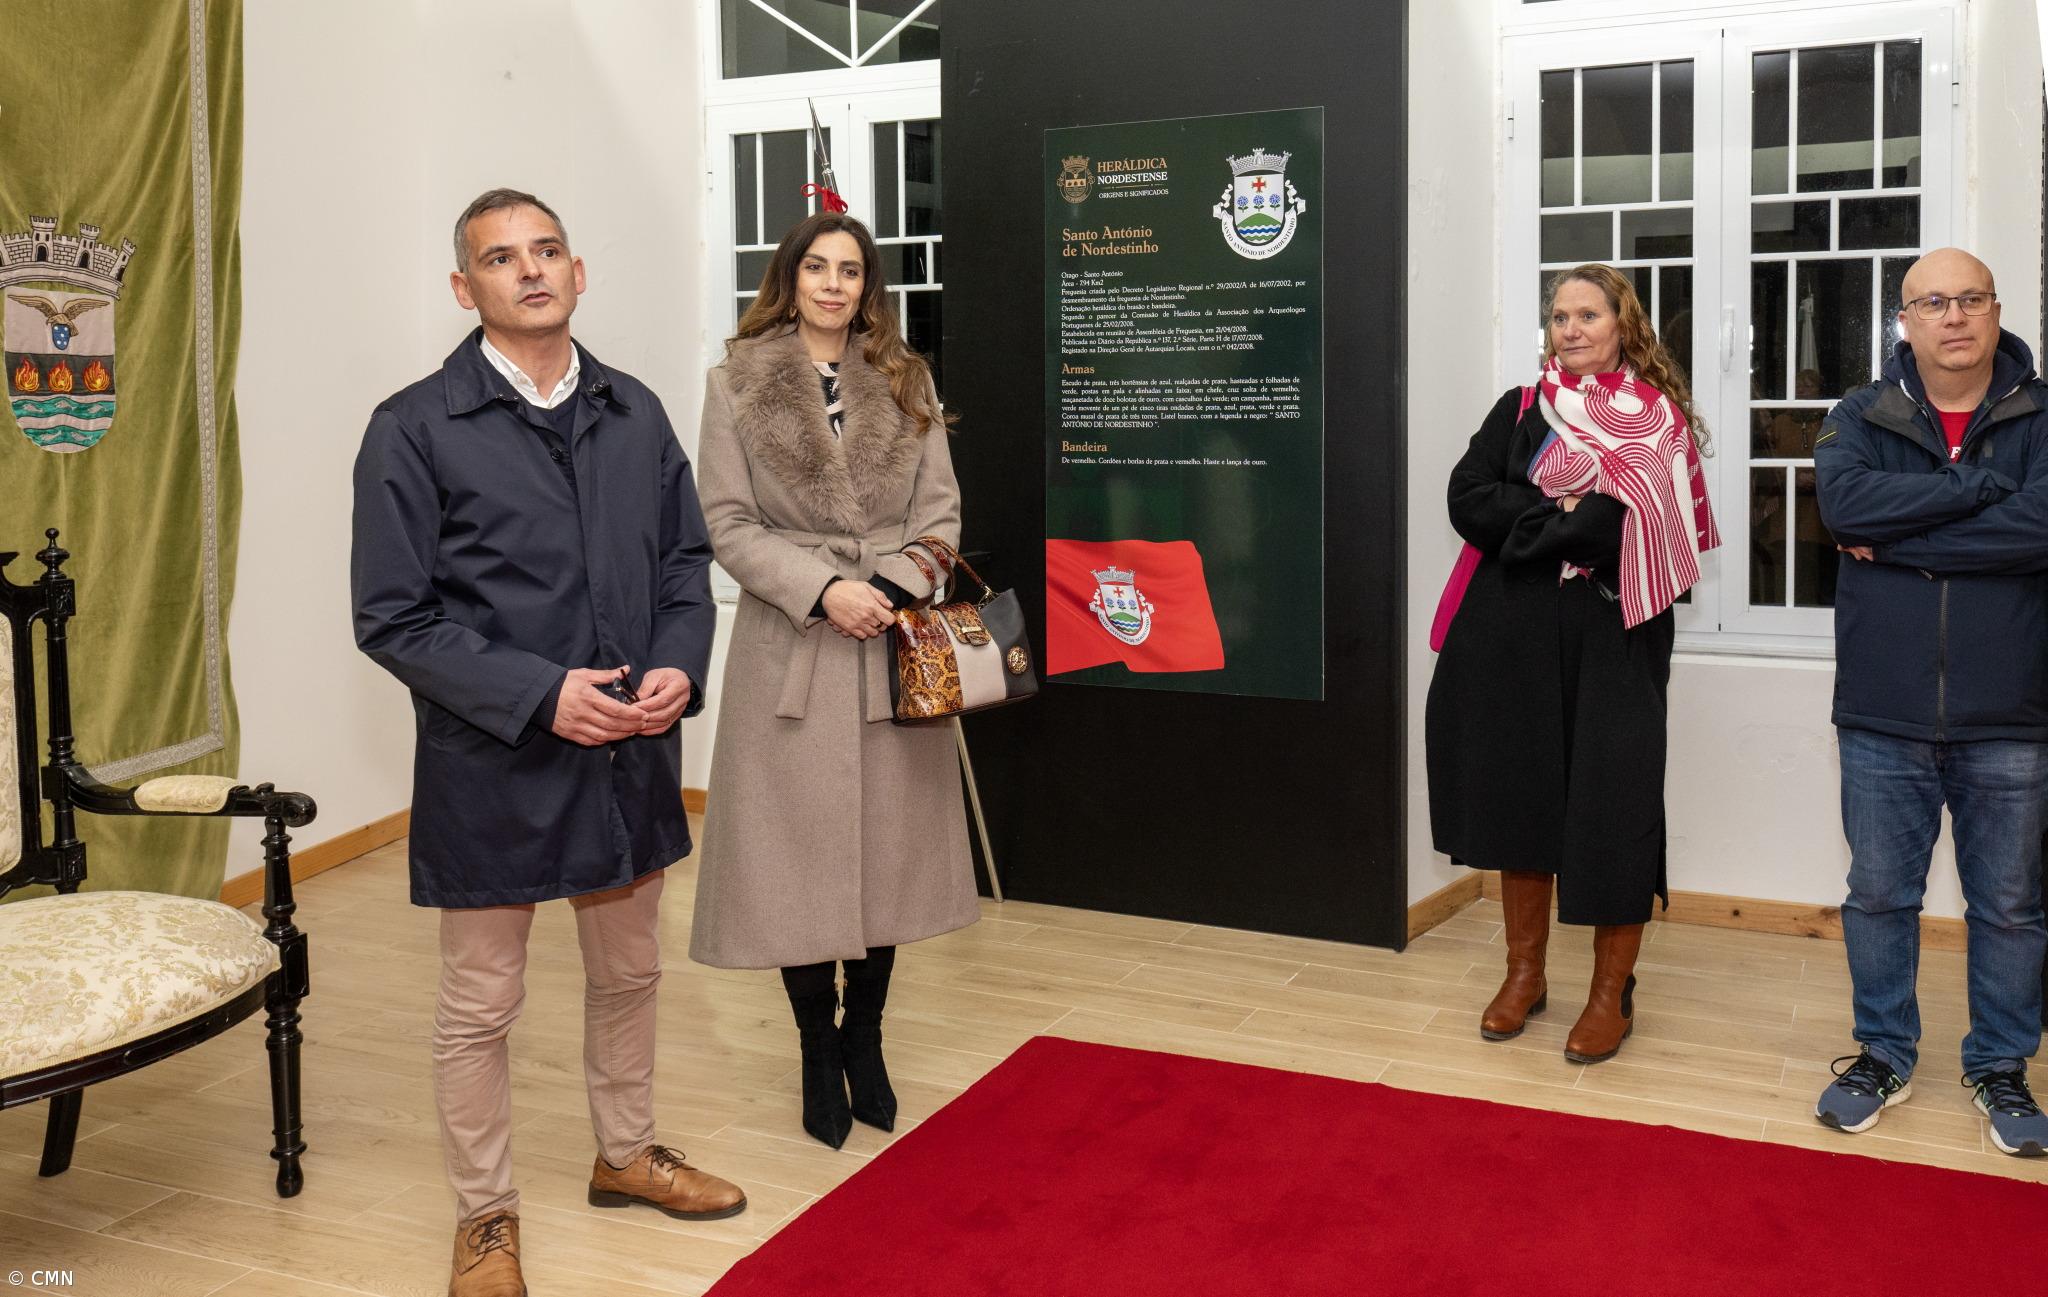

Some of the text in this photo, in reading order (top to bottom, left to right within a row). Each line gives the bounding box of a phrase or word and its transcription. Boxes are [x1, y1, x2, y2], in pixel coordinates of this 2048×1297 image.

[1097, 157, 1168, 173] HERÁLDICA
[1097, 172, 1168, 185] NORDESTENSE
[1099, 191, 1123, 199] ORIGENS
[1130, 189, 1169, 197] SIGNIFICADOS
[1063, 225, 1152, 241] Santo António
[1063, 240, 1159, 256] de Nordestinho
[1061, 288, 1087, 296] Freguesia
[1108, 287, 1119, 295] pelo
[1178, 284, 1203, 292] Regional
[1216, 282, 1247, 290] 29/2002/A
[1117, 295, 1141, 303] freguesia
[1217, 309, 1249, 317] Associação
[1268, 306, 1306, 315] Arqueólogos
[1145, 345, 1174, 353] Autarquias
[1062, 363, 1095, 374] Armas
[1174, 378, 1200, 386] realçadas
[1062, 441, 1107, 452] Bandeira
[1226, 458, 1242, 466] lança
